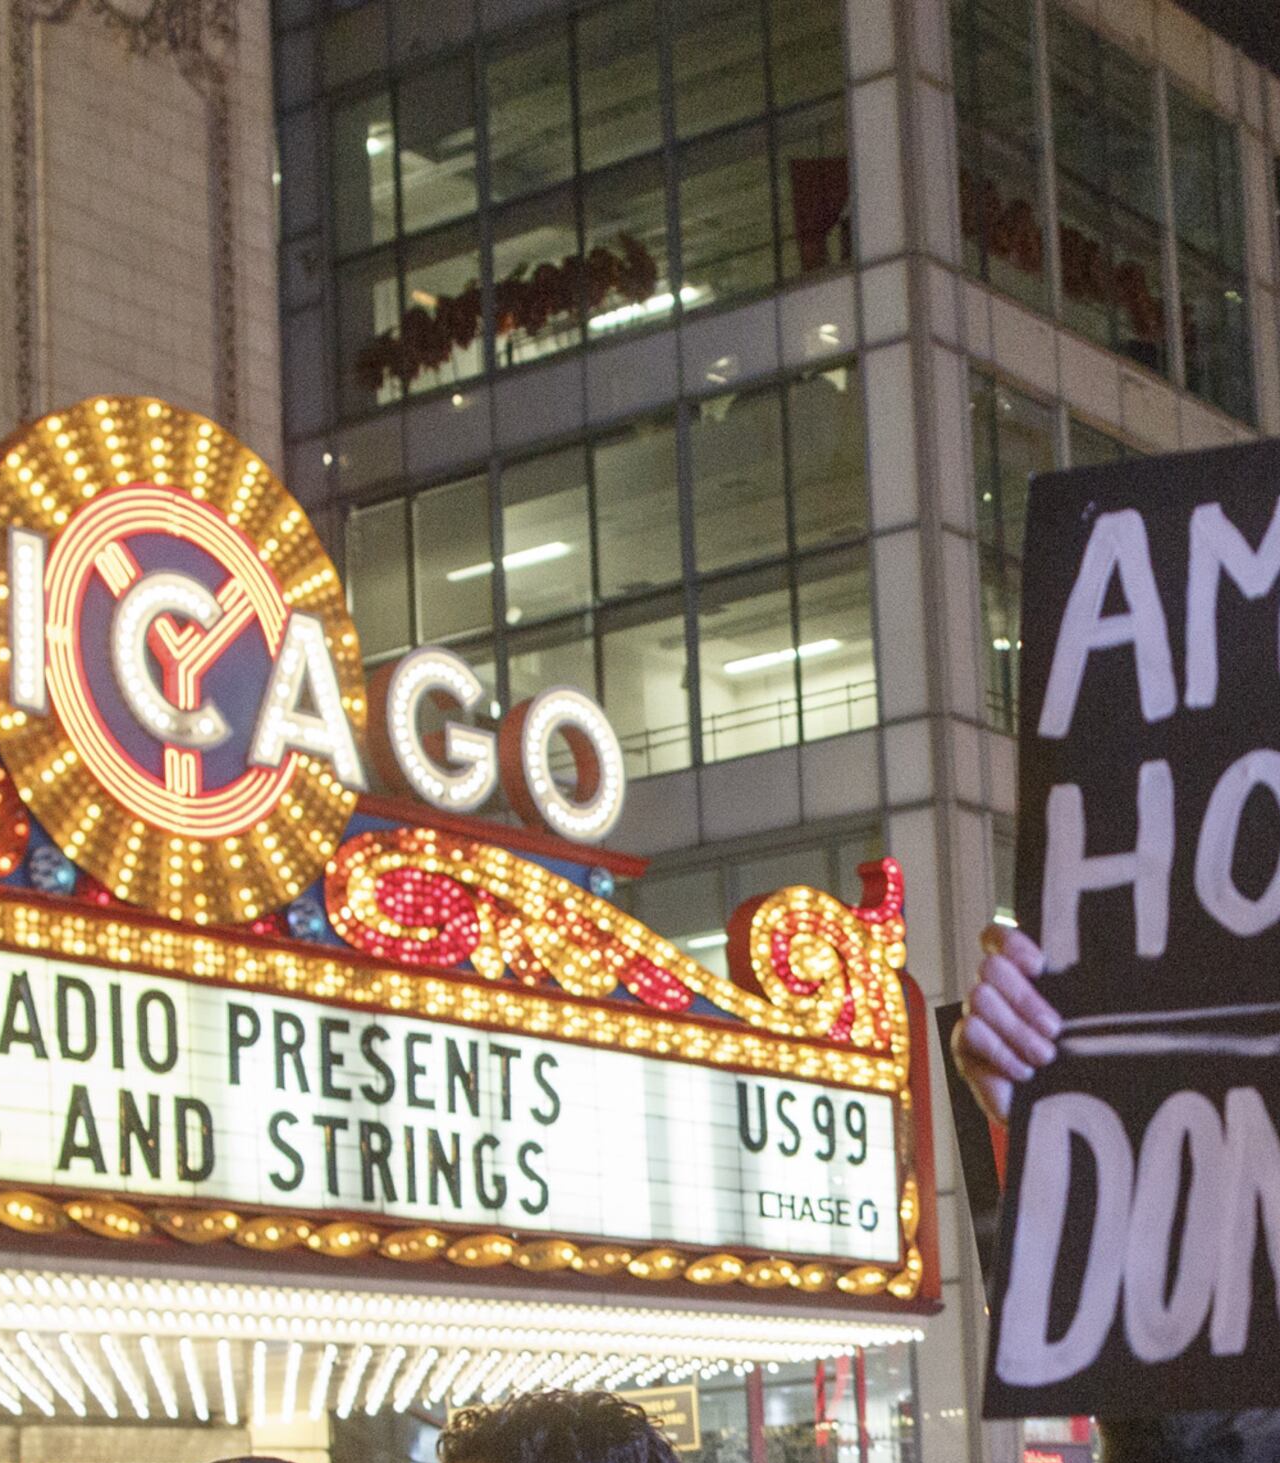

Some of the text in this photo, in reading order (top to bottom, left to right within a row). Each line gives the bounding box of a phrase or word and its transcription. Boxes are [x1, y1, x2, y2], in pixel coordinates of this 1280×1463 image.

[227, 1002, 560, 1126] PRESENTS
[57, 1085, 216, 1184] AND
[269, 1111, 549, 1215] STRINGS
[736, 1080, 867, 1166] US99
[758, 1190, 851, 1227] CHASE
